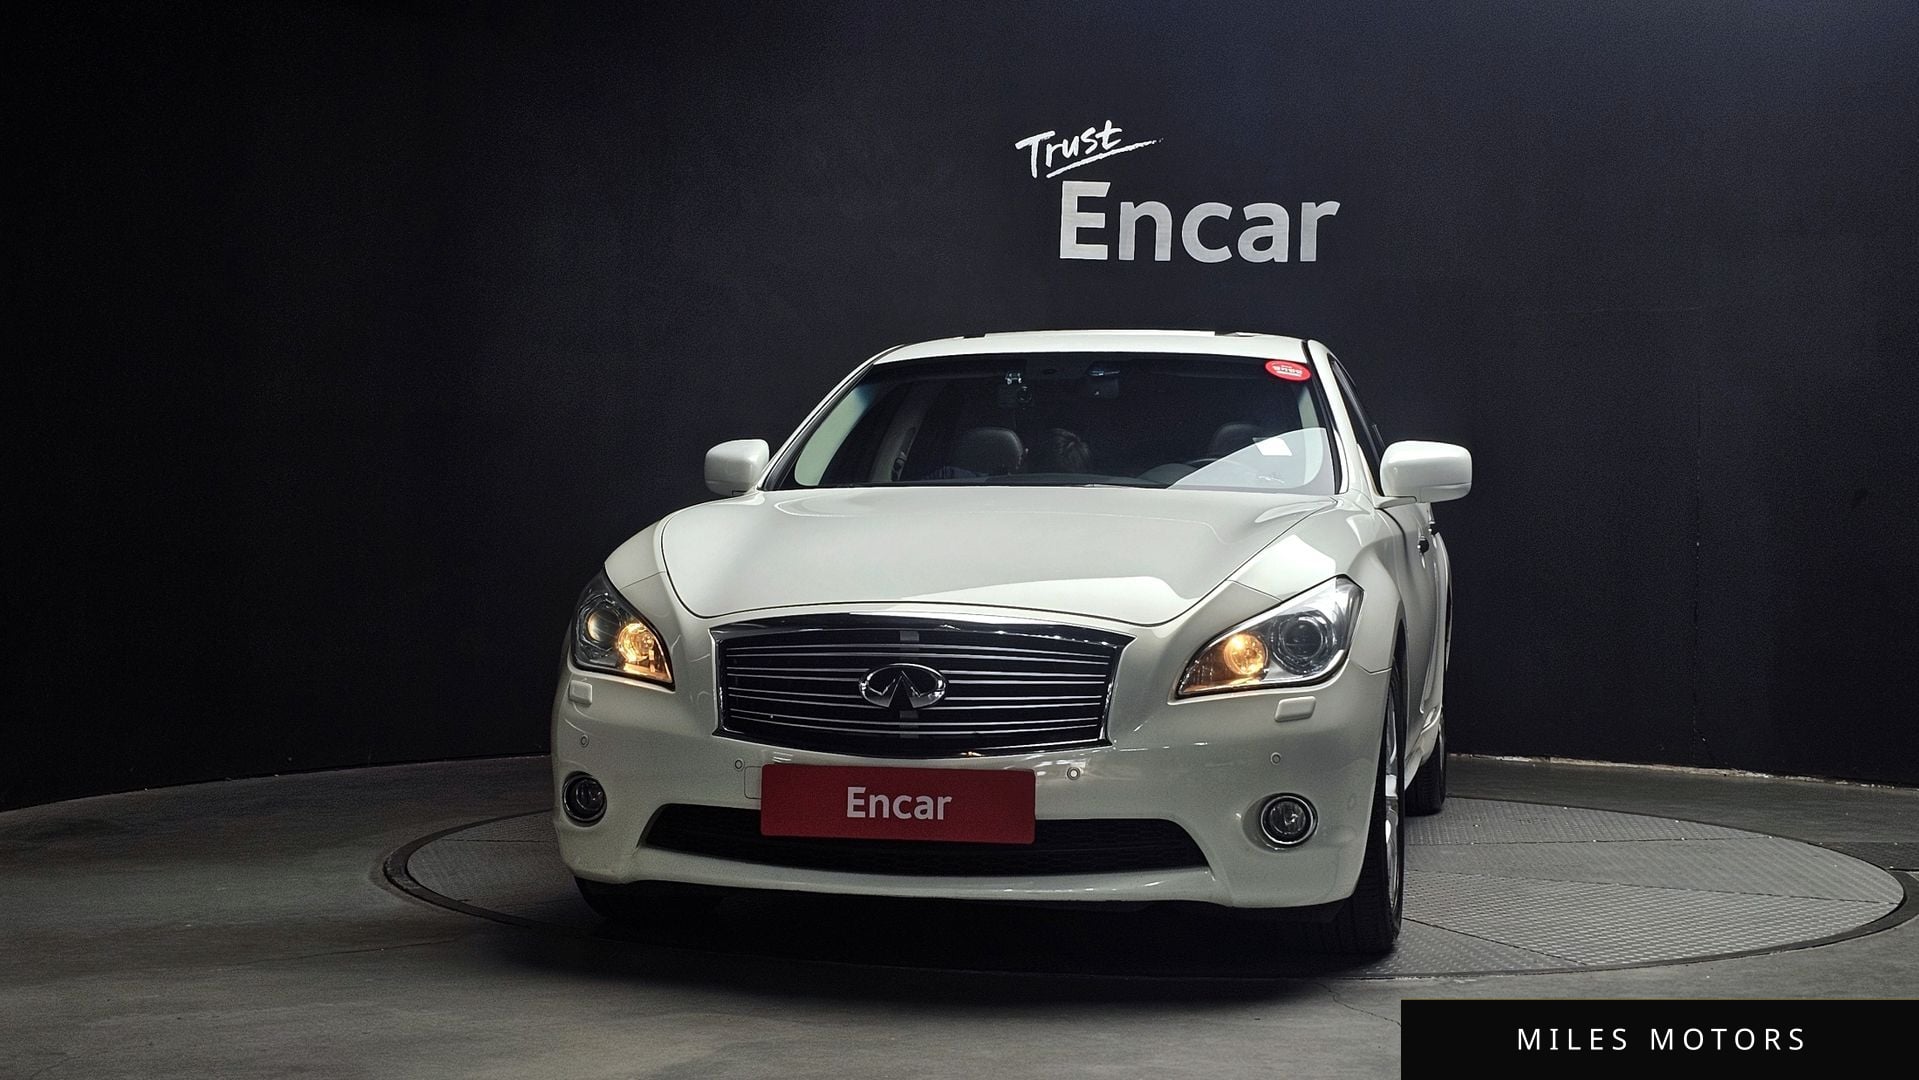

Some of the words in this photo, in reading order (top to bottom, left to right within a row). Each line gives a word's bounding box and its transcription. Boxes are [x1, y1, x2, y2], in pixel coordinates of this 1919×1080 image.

[1015, 120, 1123, 178] Trust
[1060, 181, 1341, 263] Encar
[847, 786, 953, 820] Encar
